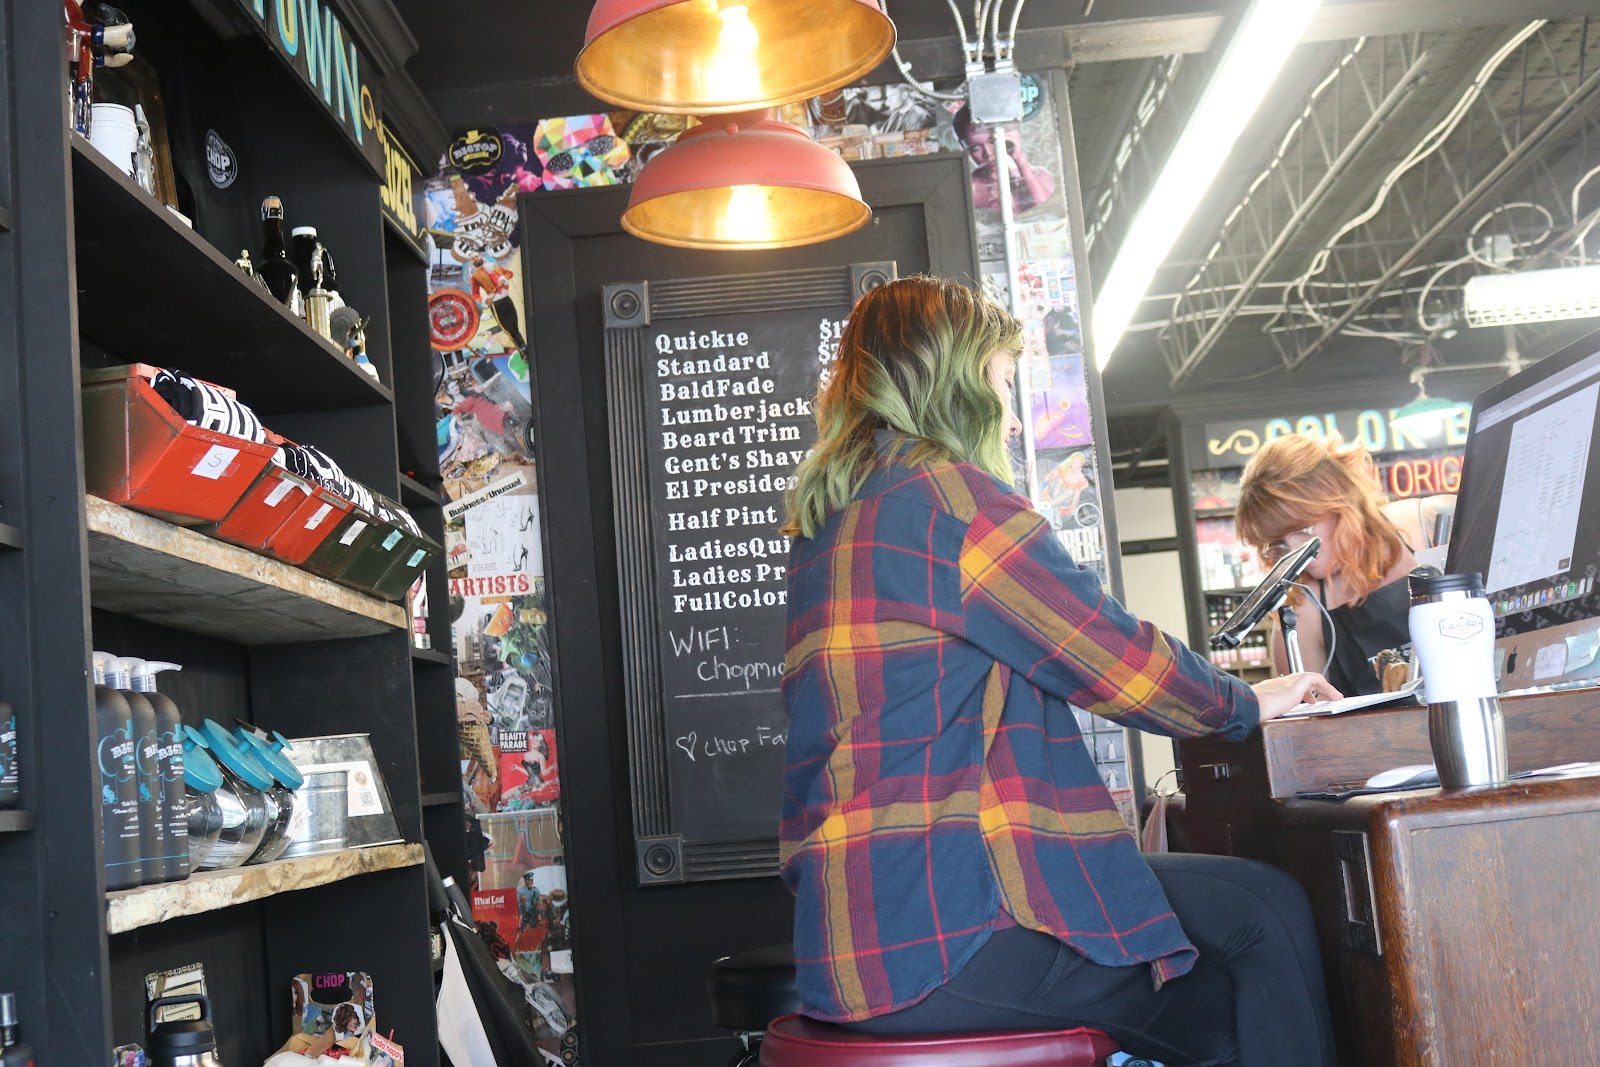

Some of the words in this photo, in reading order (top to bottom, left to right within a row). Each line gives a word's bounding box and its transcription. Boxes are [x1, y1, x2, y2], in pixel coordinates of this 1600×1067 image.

[253, 0, 363, 146] OWN
[1020, 85, 1039, 102] OP
[655, 330, 749, 354] Quickie
[657, 351, 770, 377] Standard
[661, 397, 812, 426] Lumberjack
[207, 452, 224, 468] S
[664, 452, 740, 474] Gent's
[1389, 455, 1465, 499] ORIG
[665, 480, 690, 500] El
[668, 508, 722, 531] Half
[725, 506, 778, 527] Pint
[449, 573, 530, 597] ARTISTS
[672, 565, 752, 587] Ladies
[669, 625, 740, 658] WIFI:
[500, 732, 527, 741] BEAUTY
[500, 741, 528, 749] PARADE
[756, 726, 788, 746] Fa
[316, 974, 345, 988] CHOP
